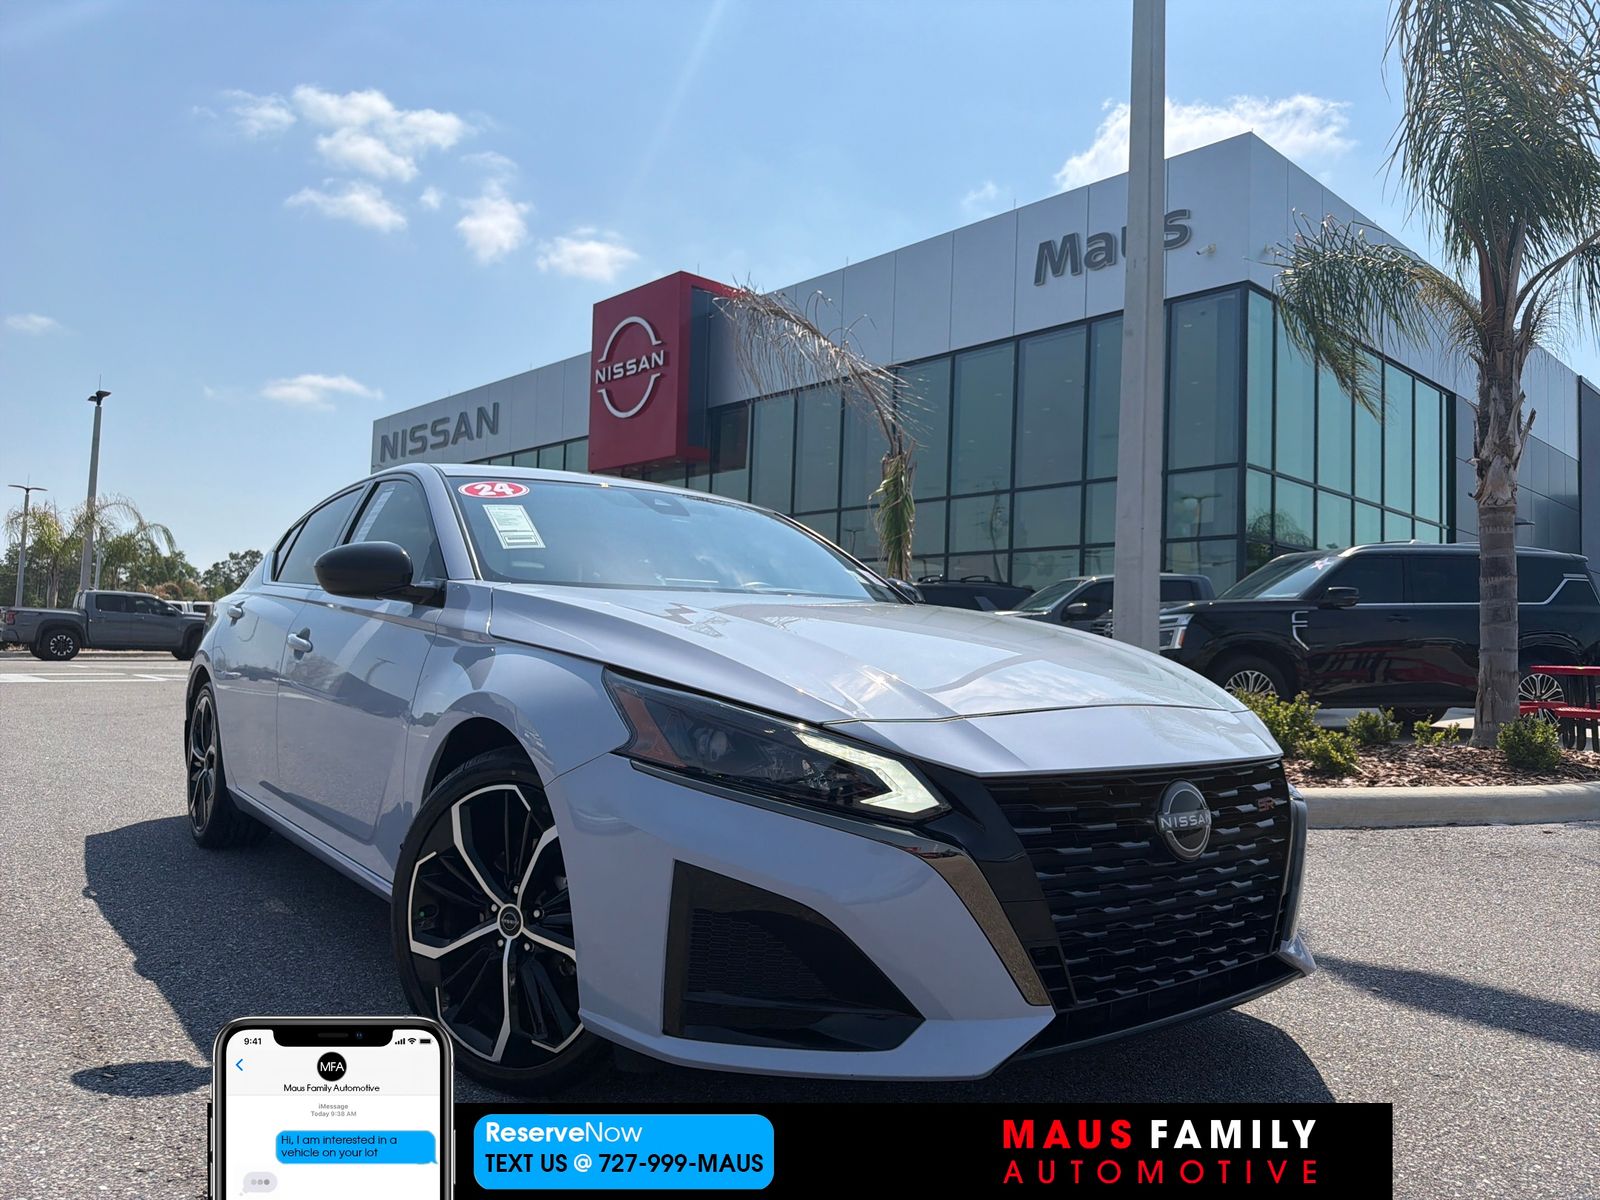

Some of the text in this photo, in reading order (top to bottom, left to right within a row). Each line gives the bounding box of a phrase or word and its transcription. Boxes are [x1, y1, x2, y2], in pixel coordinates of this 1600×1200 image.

[1034, 209, 1192, 286] Mas
[595, 350, 664, 385] NISSAN
[379, 401, 500, 463] NISSAN
[474, 482, 514, 496] 24
[1160, 812, 1211, 829] NISSAN
